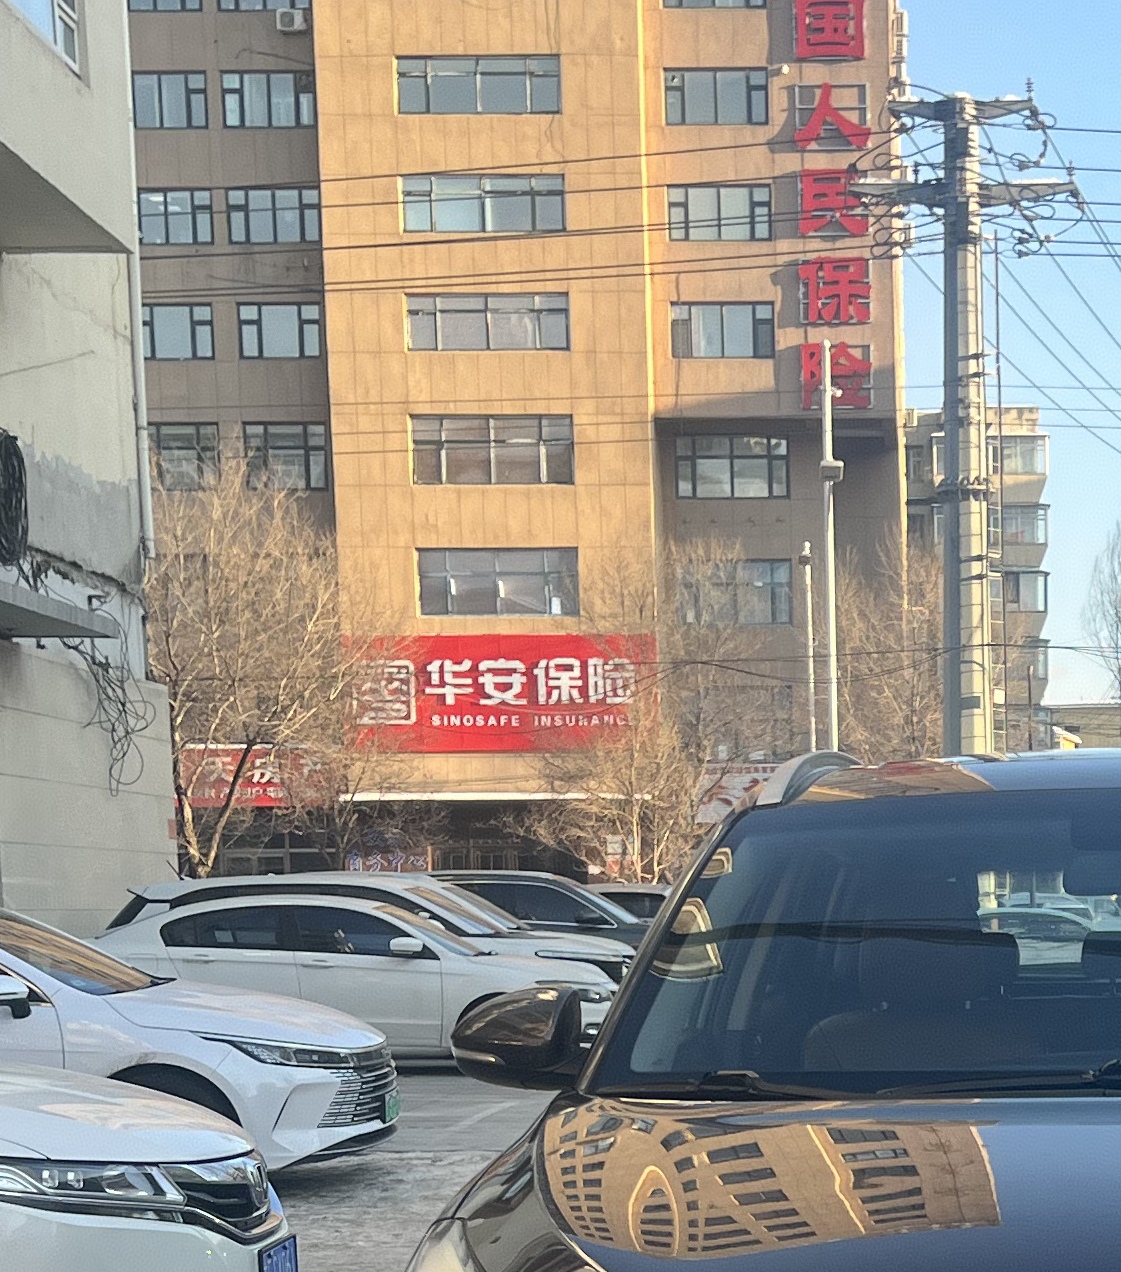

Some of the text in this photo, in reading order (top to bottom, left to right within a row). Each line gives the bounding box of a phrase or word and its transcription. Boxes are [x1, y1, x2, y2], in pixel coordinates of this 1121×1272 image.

[425, 657, 636, 705] 华安保险
[431, 714, 634, 727] SINOSAFE INSURANC
